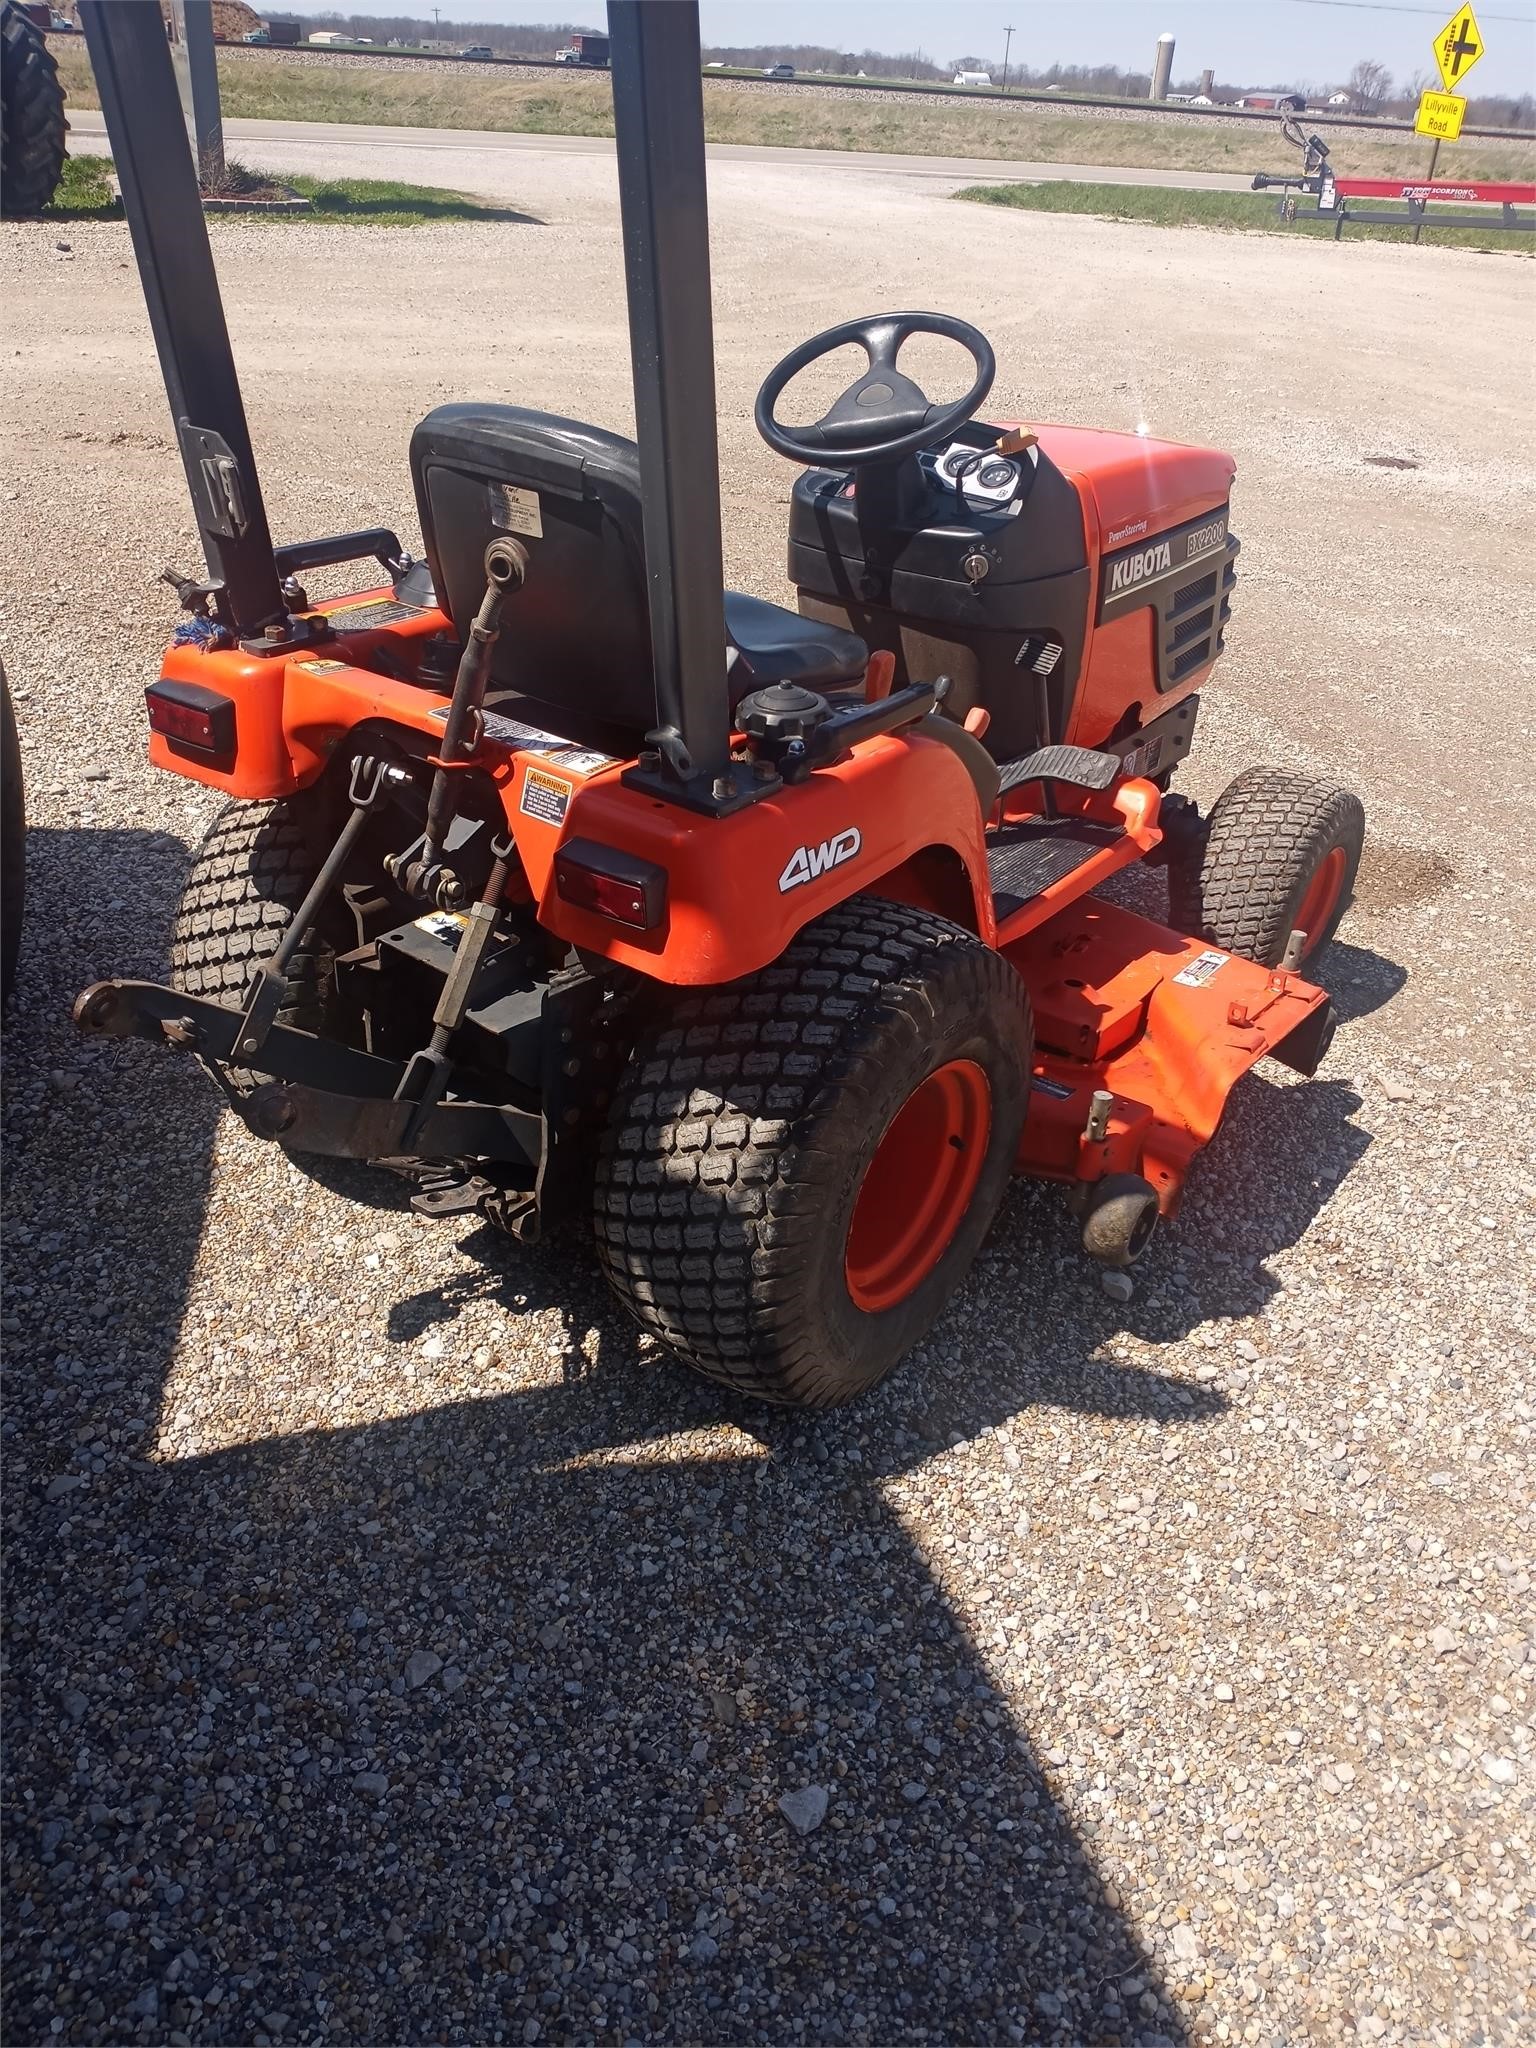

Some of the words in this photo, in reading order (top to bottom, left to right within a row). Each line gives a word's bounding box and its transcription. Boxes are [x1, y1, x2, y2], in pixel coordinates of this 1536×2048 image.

[1425, 98, 1458, 116] Lillyville
[1428, 116, 1448, 132] Road
[1432, 187, 1468, 195] SCORPION
[1108, 519, 1147, 544] PowerSteering
[1111, 541, 1171, 591] KUBOTA
[1186, 520, 1224, 558] BX2200
[536, 775, 568, 793] WARNING
[778, 826, 862, 894] 4WD
